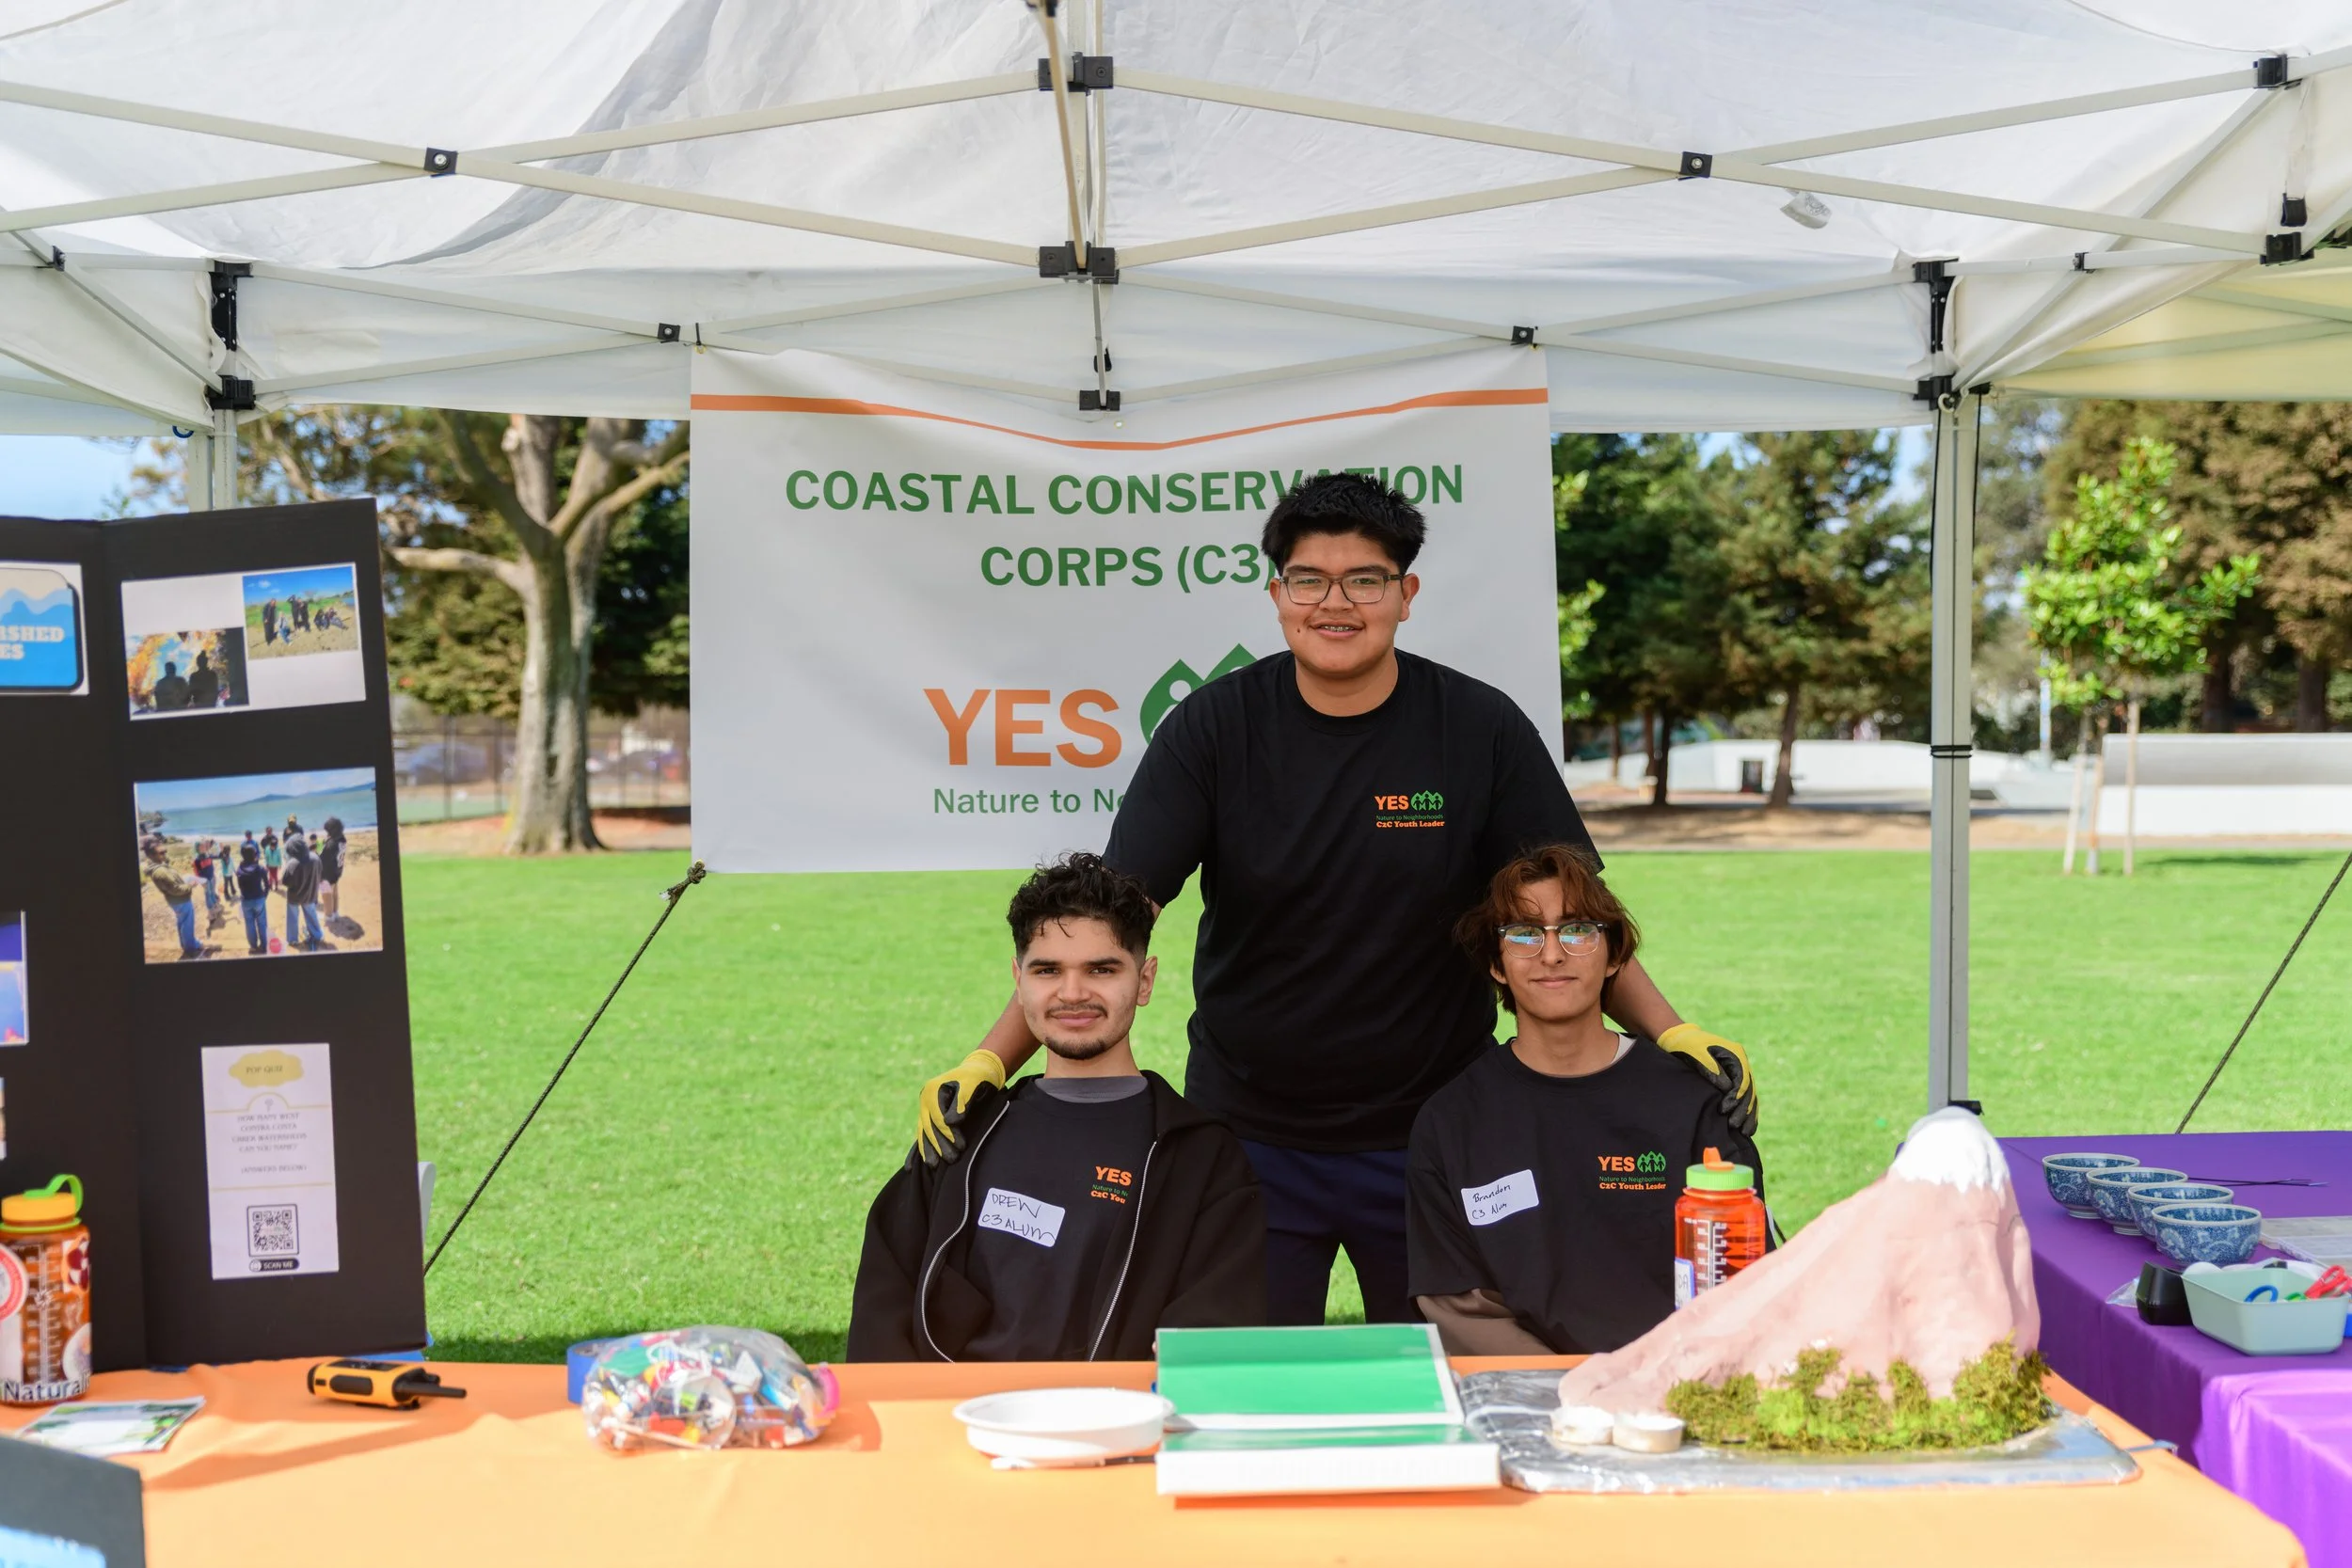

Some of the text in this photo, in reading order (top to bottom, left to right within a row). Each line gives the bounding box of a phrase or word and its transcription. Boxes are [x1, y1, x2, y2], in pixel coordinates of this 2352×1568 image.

[787, 465, 1462, 515] COASTAL CONSERVION
[980, 546, 1163, 587] CORPS
[923, 689, 1122, 768] YES
[934, 788, 1040, 814] Nature
[1050, 789, 1081, 814] to
[1375, 795, 1409, 811] YES
[246, 1065, 283, 1074] POP QUIZ
[1597, 1156, 1635, 1172] YES
[1095, 1165, 1133, 1186] YES
[1091, 1184, 1113, 1193] Nature
[992, 1193, 1041, 1219] DREW
[1472, 1210, 1486, 1220] C3
[263, 1261, 282, 1270] SCAN
